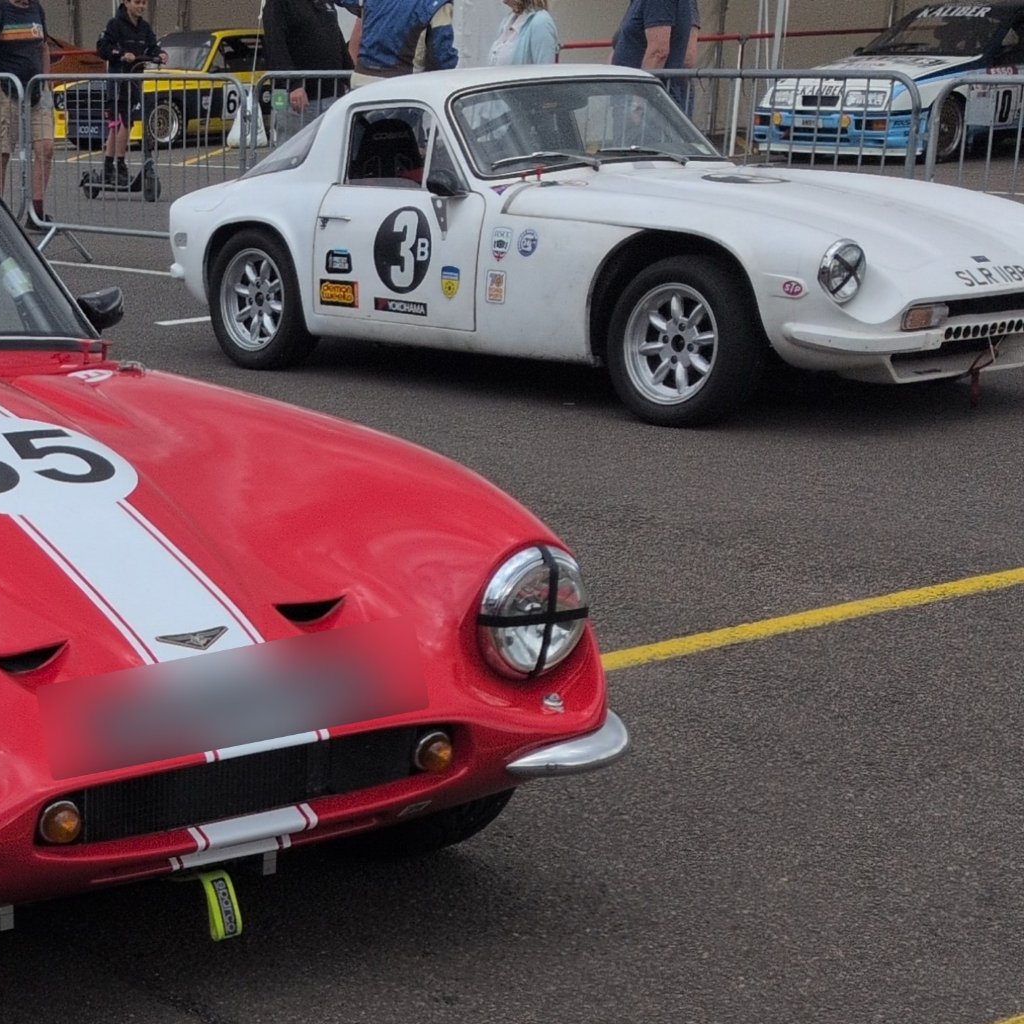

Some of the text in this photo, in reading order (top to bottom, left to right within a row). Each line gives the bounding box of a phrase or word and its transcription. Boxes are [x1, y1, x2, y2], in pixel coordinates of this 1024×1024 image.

[916, 6, 992, 18] KALIBER
[799, 85, 845, 97] KAIBER
[954, 267, 999, 287] SLR
[387, 300, 425, 314] YOKOHAMA
